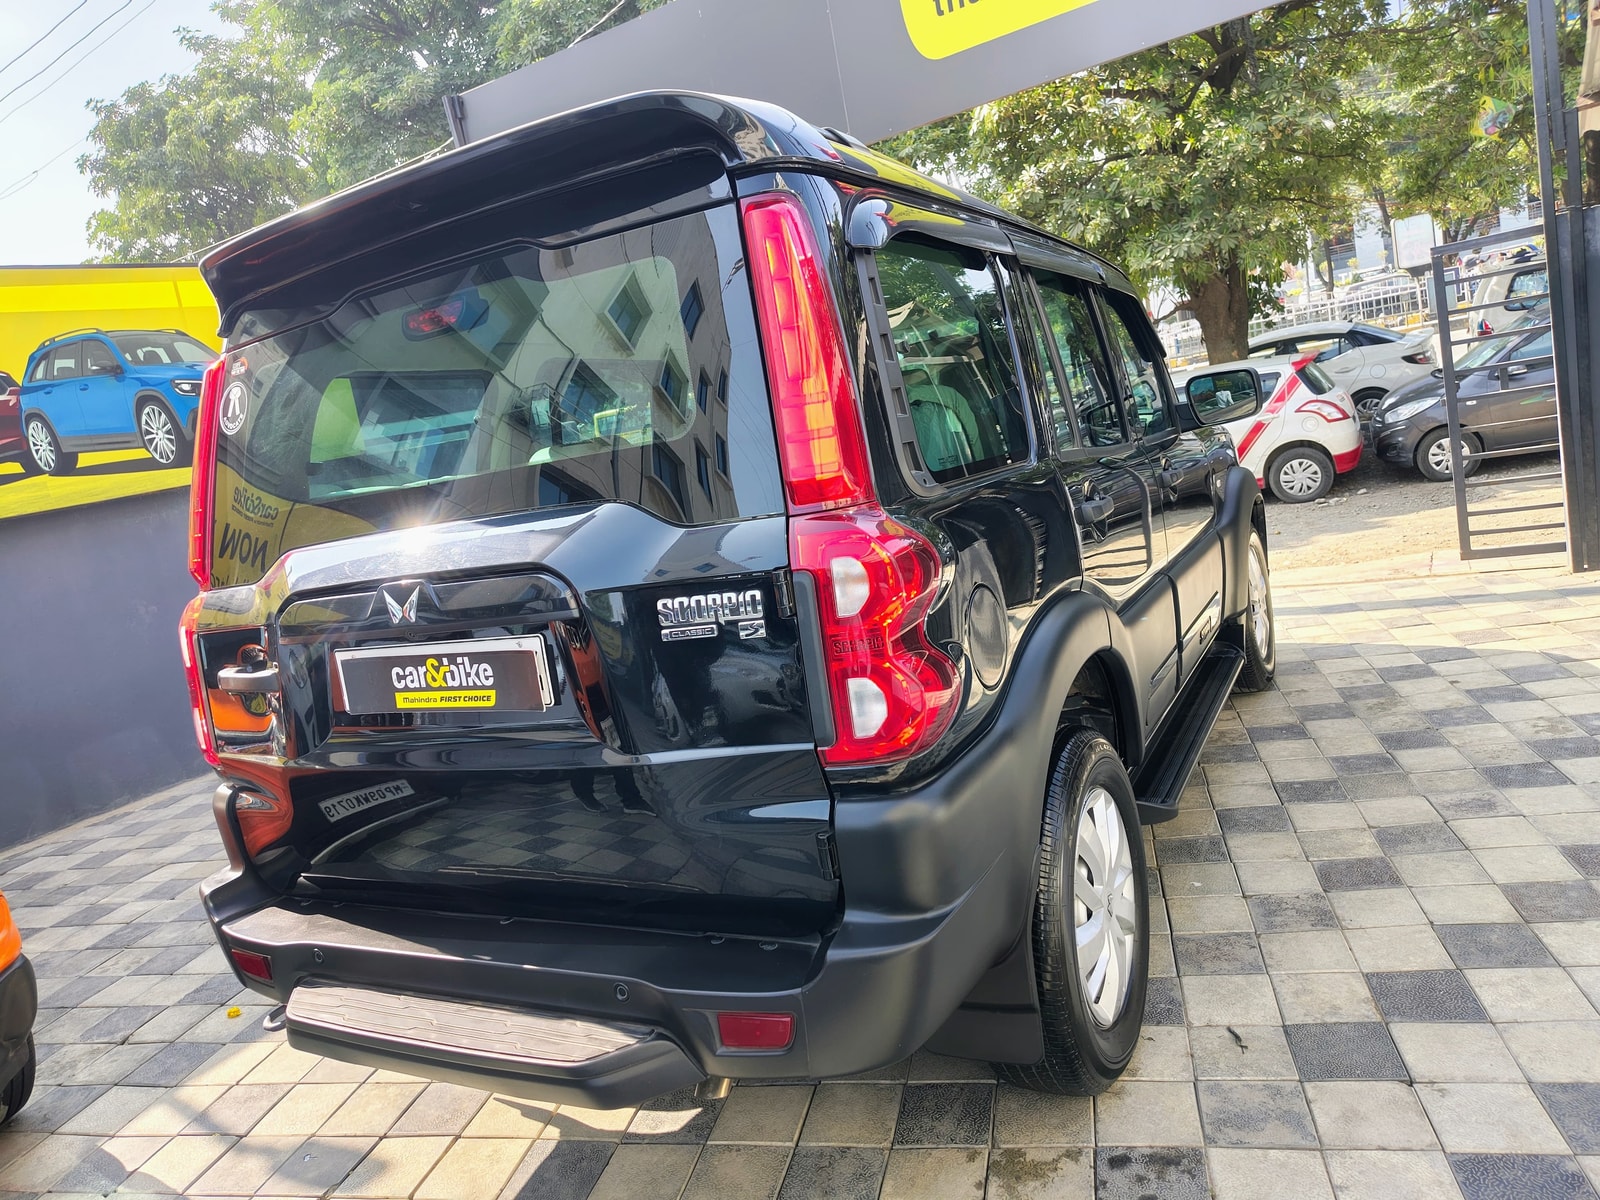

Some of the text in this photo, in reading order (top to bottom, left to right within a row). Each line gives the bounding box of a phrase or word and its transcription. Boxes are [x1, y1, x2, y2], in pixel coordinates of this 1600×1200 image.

[656, 589, 764, 626] SCORPIO
[669, 627, 714, 638] CLASSIC
[391, 656, 494, 689] car&bike
[402, 696, 438, 704] Mahindra
[439, 695, 462, 703] FIRST
